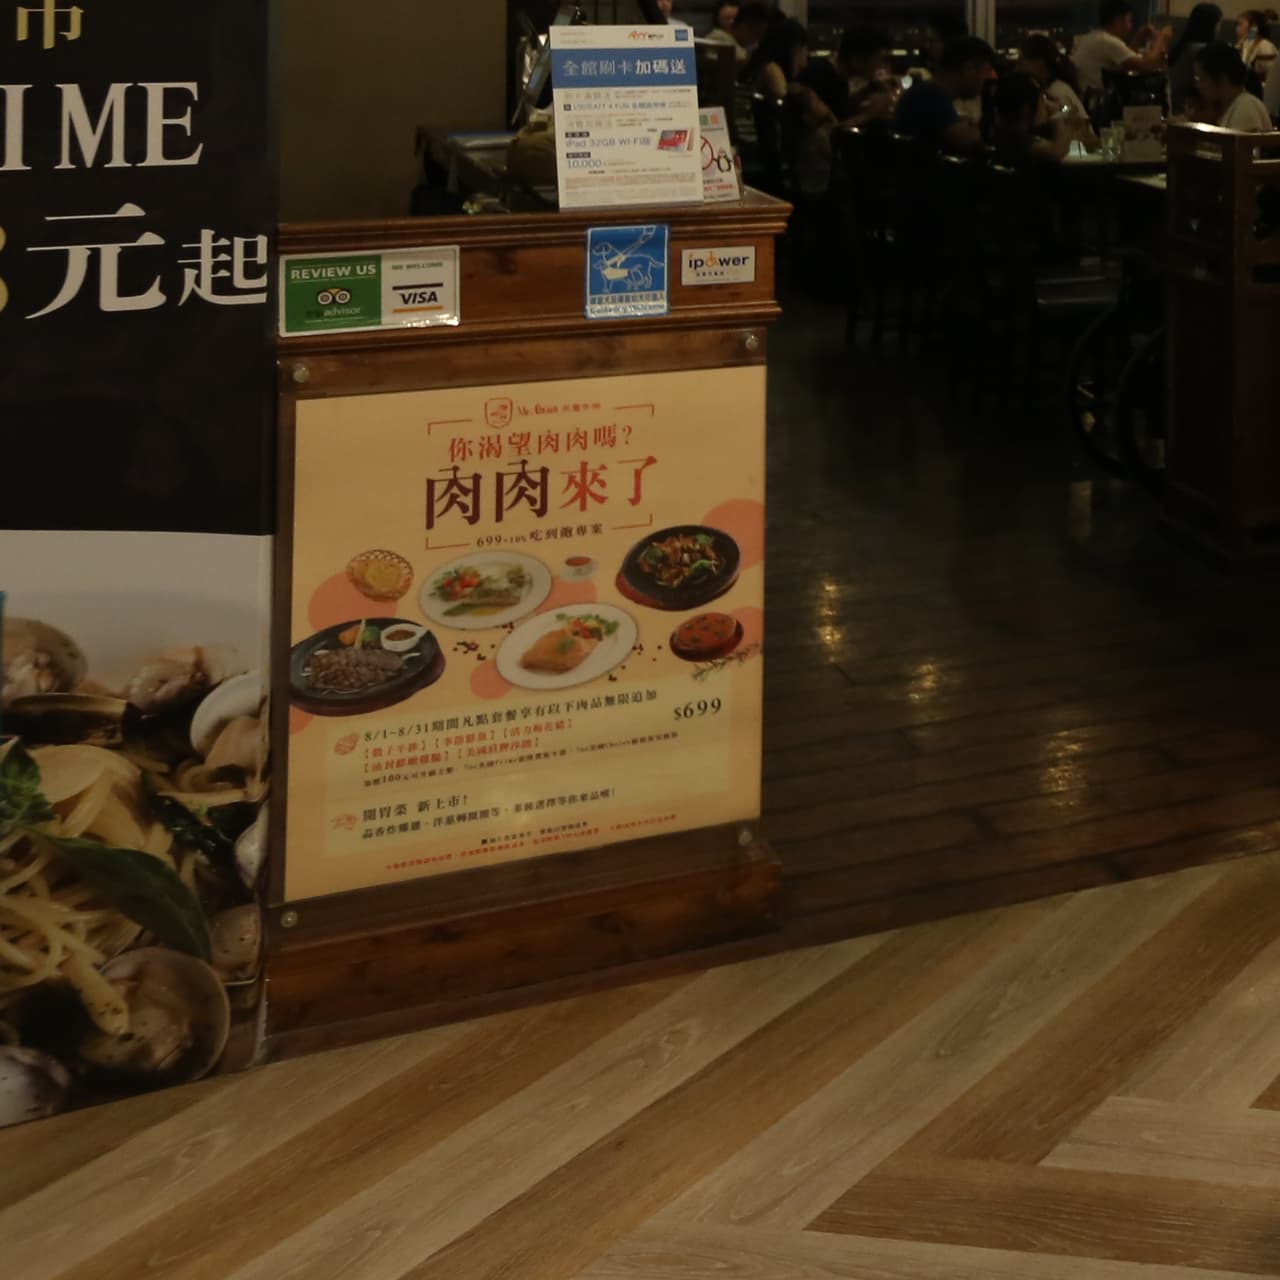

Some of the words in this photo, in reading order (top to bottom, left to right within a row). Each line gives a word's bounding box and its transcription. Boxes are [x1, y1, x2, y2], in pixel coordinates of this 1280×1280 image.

[290, 265, 352, 281] REVIEW
[356, 264, 377, 276] US
[399, 291, 438, 305] VISA
[448, 424, 633, 463] 你渴望肉肉嗎?
[426, 456, 657, 530] 肉肉來了
[673, 697, 722, 721] $699
